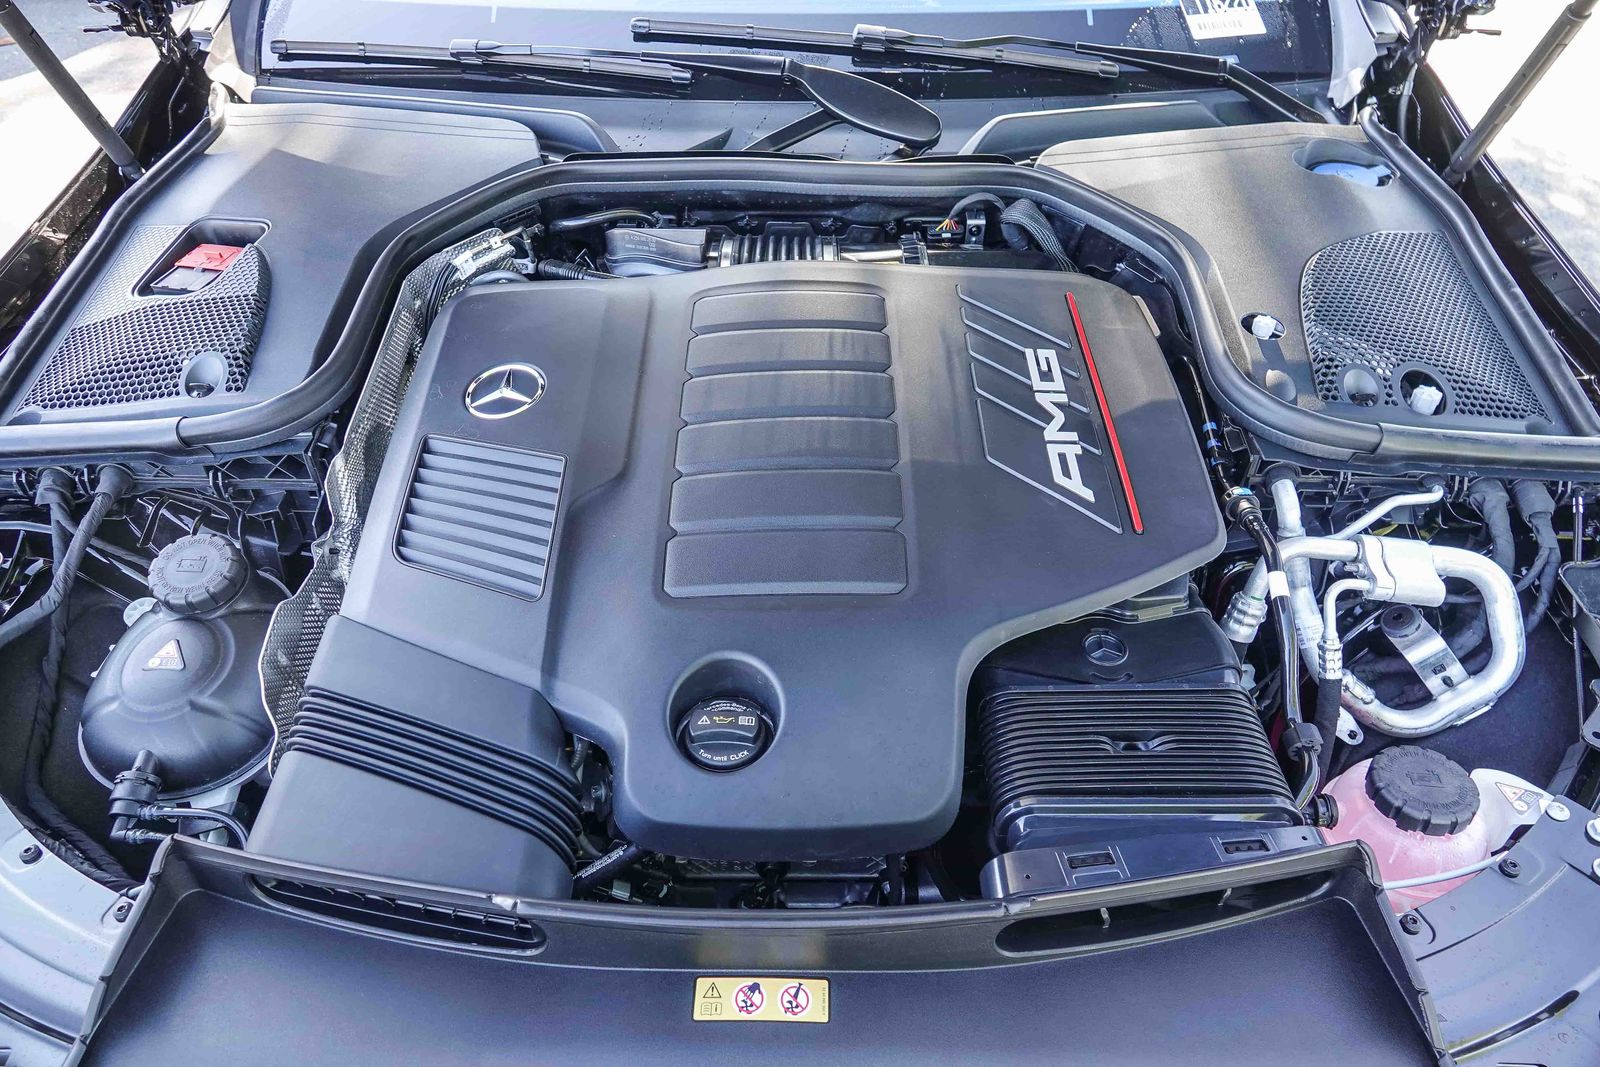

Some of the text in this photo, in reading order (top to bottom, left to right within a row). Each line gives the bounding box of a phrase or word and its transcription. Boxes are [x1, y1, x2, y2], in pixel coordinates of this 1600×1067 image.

[1024, 348, 1095, 503] AMG
[699, 749, 712, 759] Turn
[729, 750, 749, 761] CLICK
